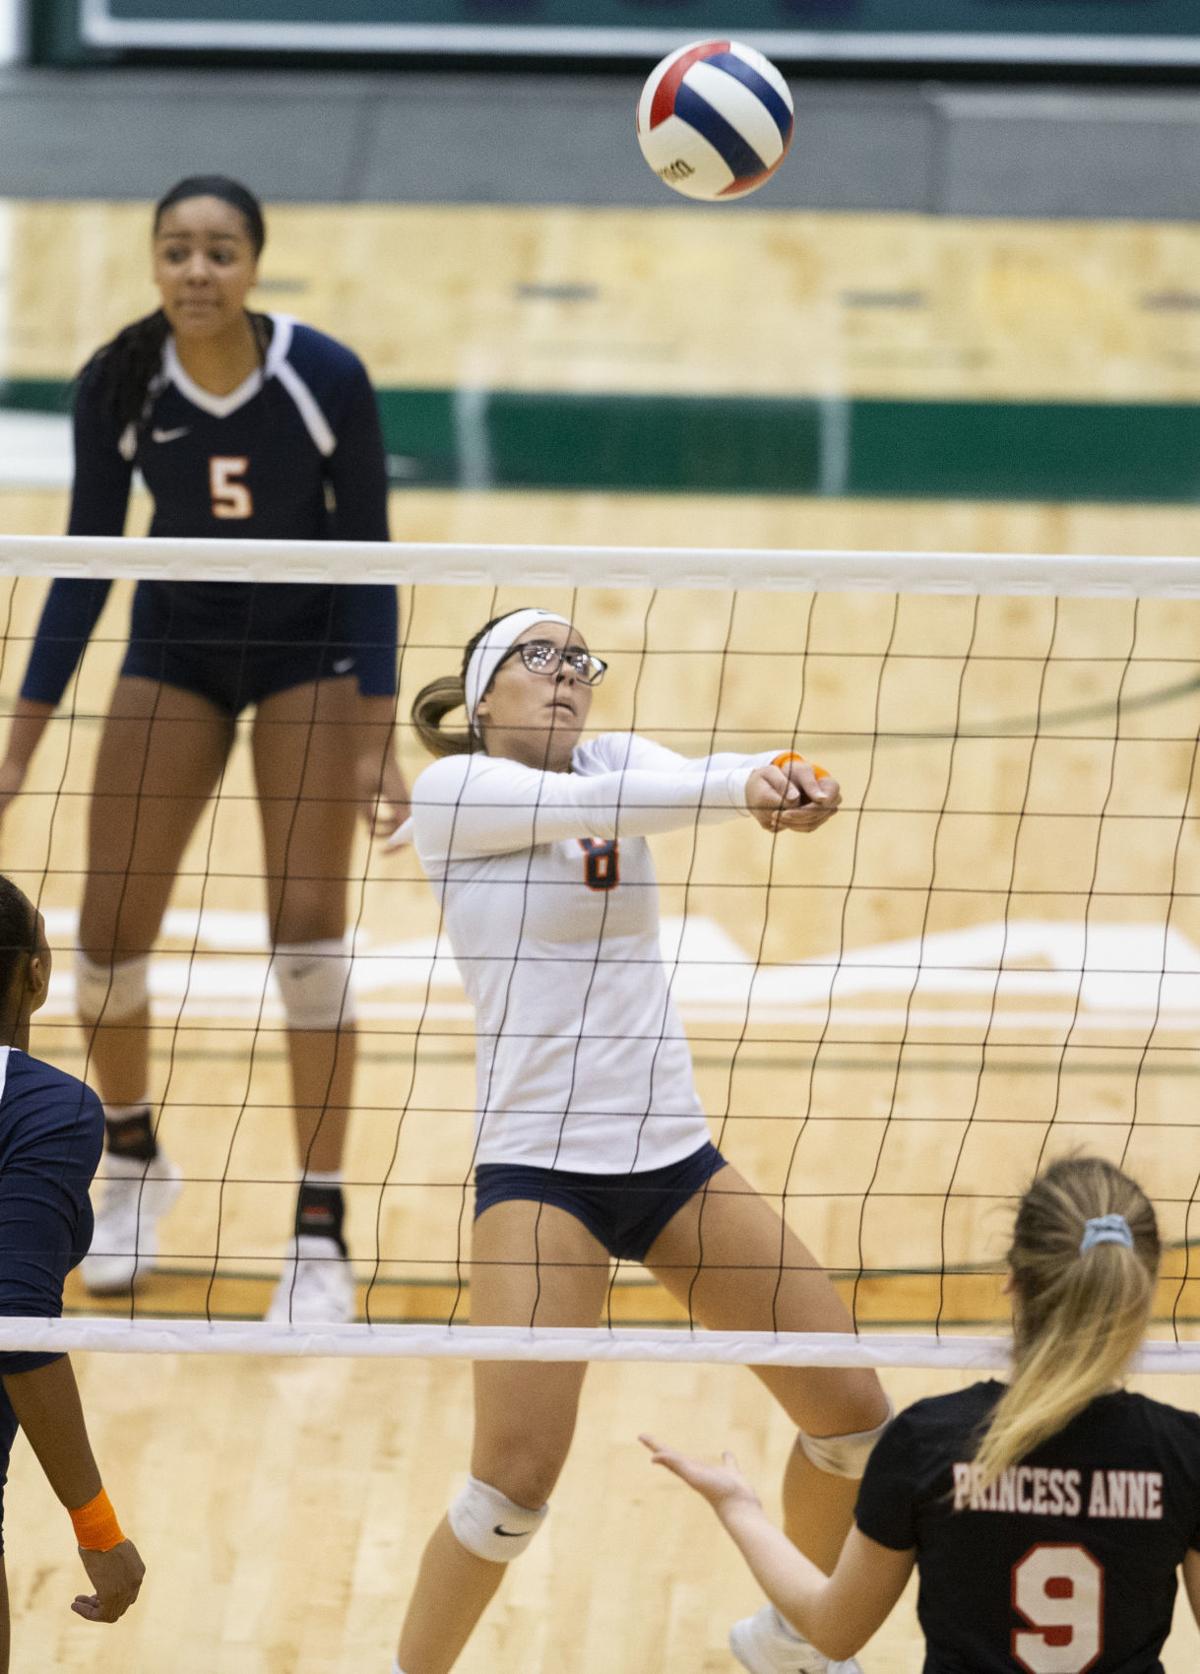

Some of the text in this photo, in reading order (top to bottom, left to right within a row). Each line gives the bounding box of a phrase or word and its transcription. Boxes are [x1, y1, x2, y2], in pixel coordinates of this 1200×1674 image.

[208, 456, 253, 520] 5
[577, 837, 620, 892] 8
[1088, 1470, 1163, 1520] ANNE
[1011, 1542, 1105, 1674] 9
